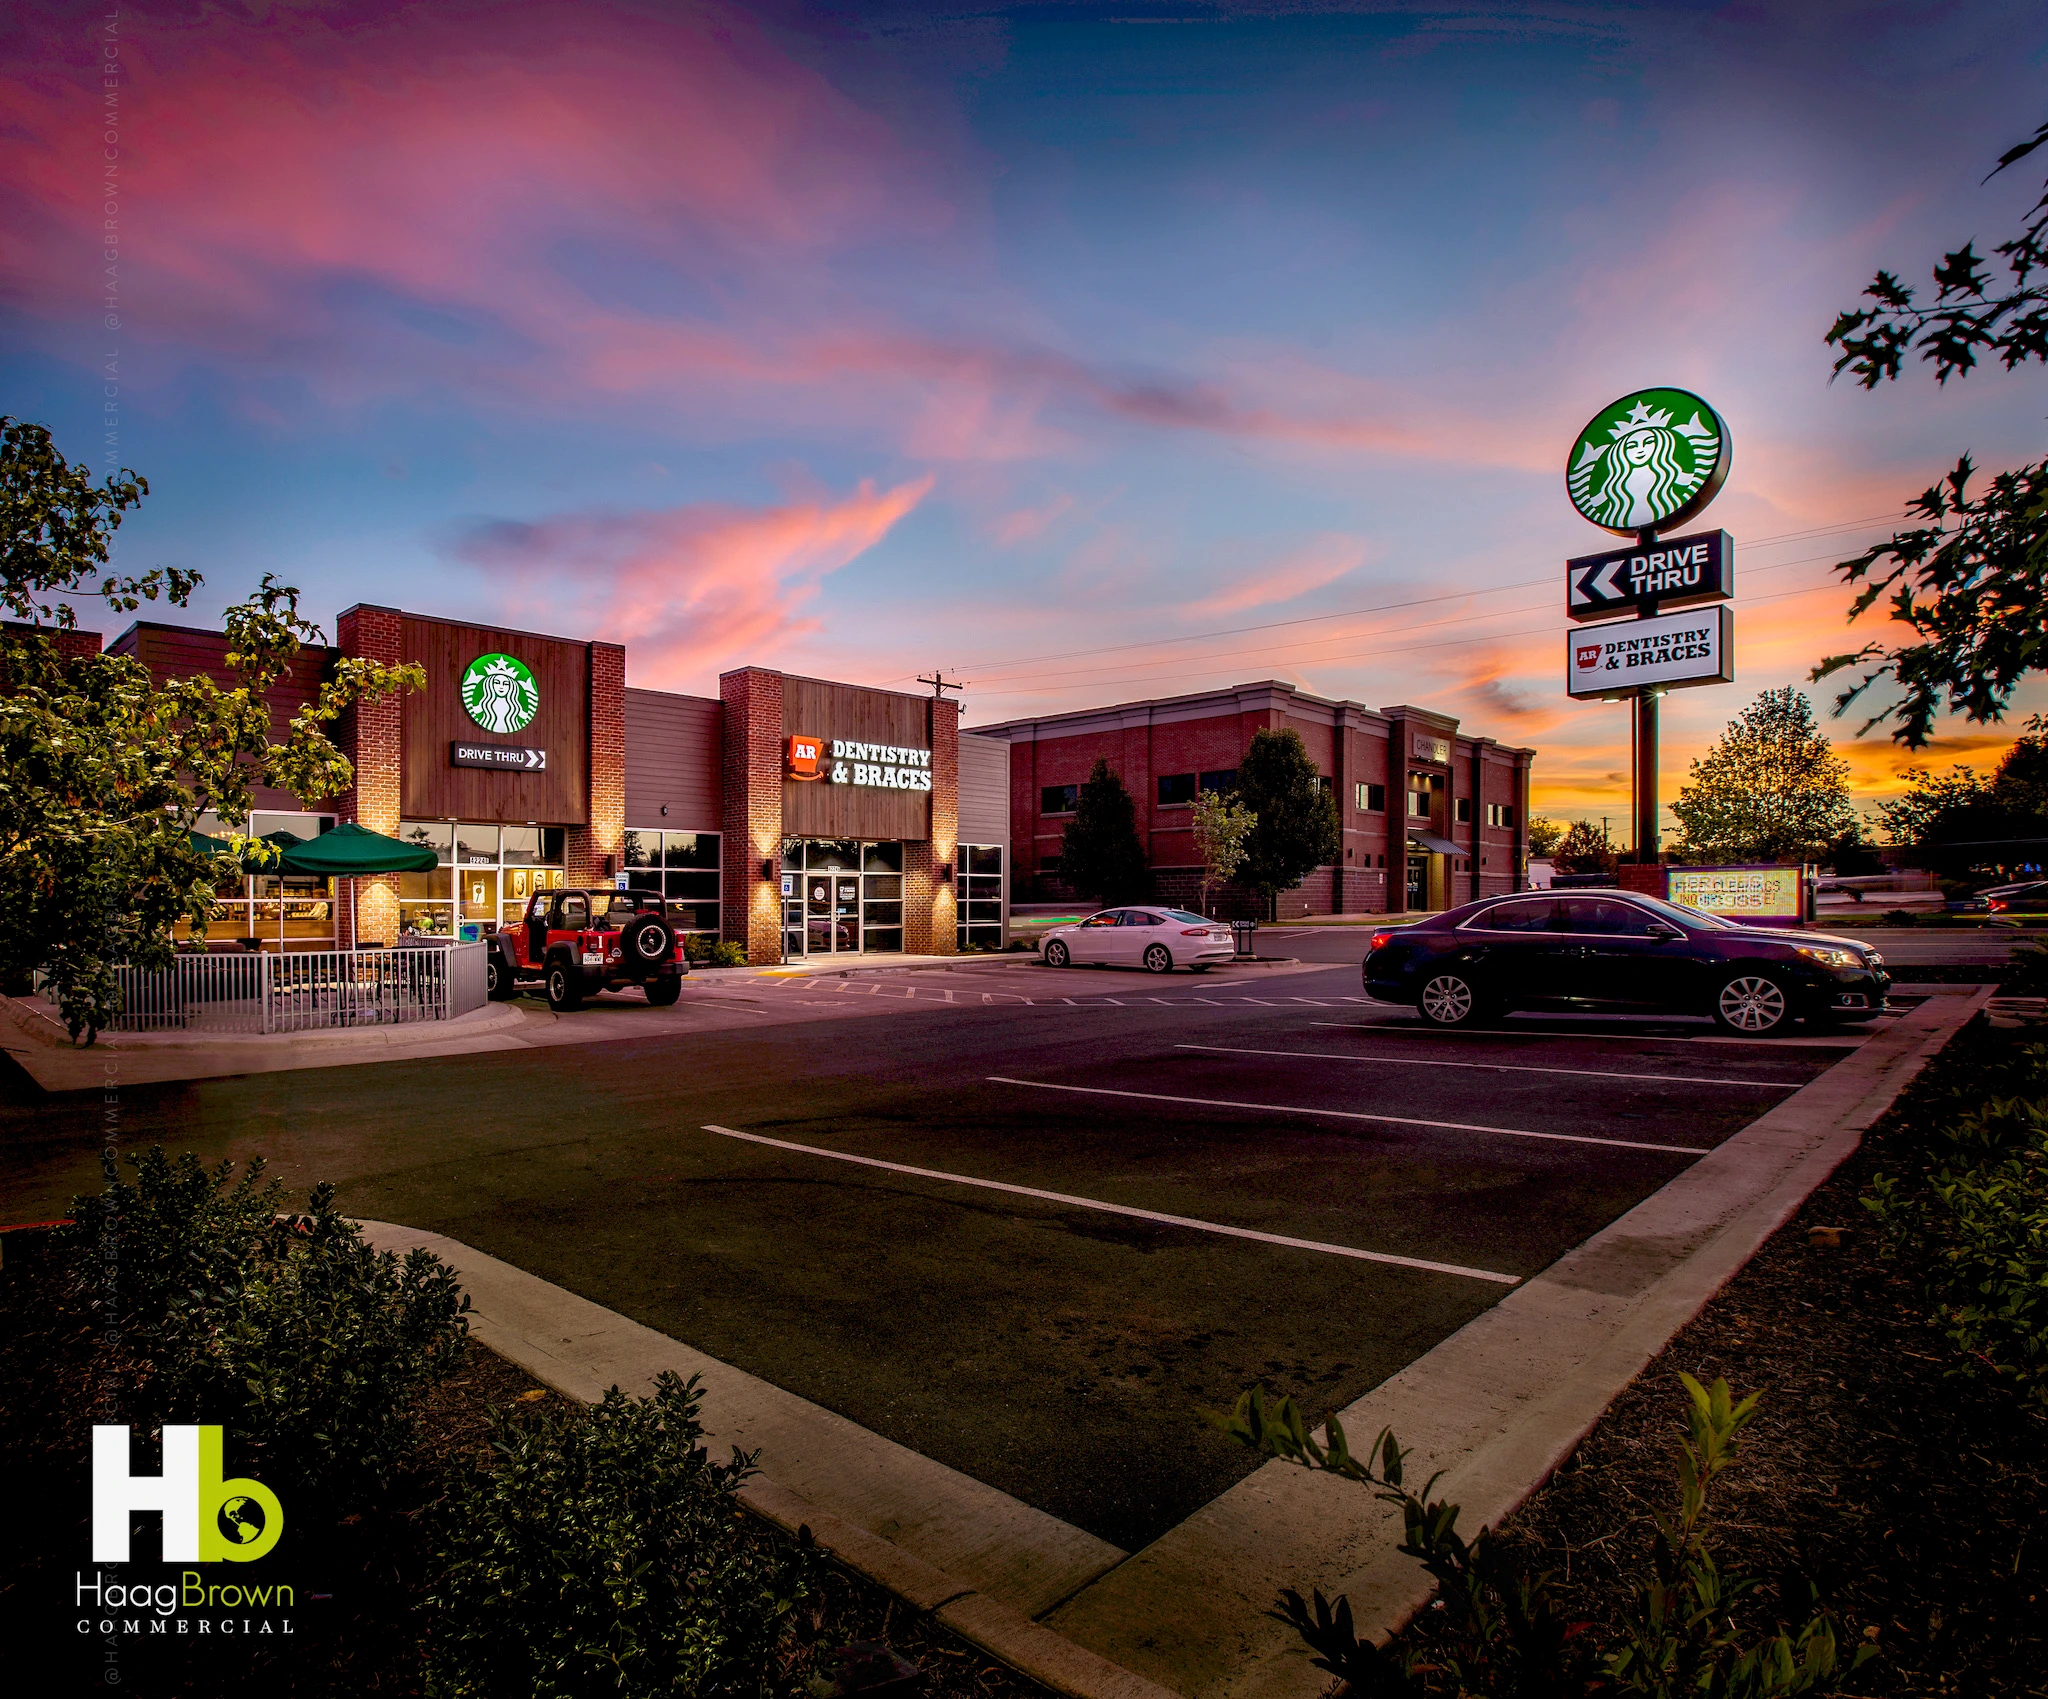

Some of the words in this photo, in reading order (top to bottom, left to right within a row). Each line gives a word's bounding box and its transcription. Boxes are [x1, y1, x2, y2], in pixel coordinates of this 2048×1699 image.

[1630, 543, 1709, 576] DRIVE
[1629, 565, 1701, 595] THRU
[1605, 628, 1711, 655] DENTISTRY
[1578, 650, 1597, 662] AR
[1605, 655, 1620, 671] &
[1626, 642, 1711, 668] BRACES
[458, 747, 492, 761] DRIVE
[493, 751, 524, 763] THRU
[794, 744, 817, 760] AR
[832, 739, 931, 767] DENTISTRY
[1416, 739, 1447, 756] CHANDLER
[831, 761, 849, 784] &
[853, 763, 932, 791] BRACES
